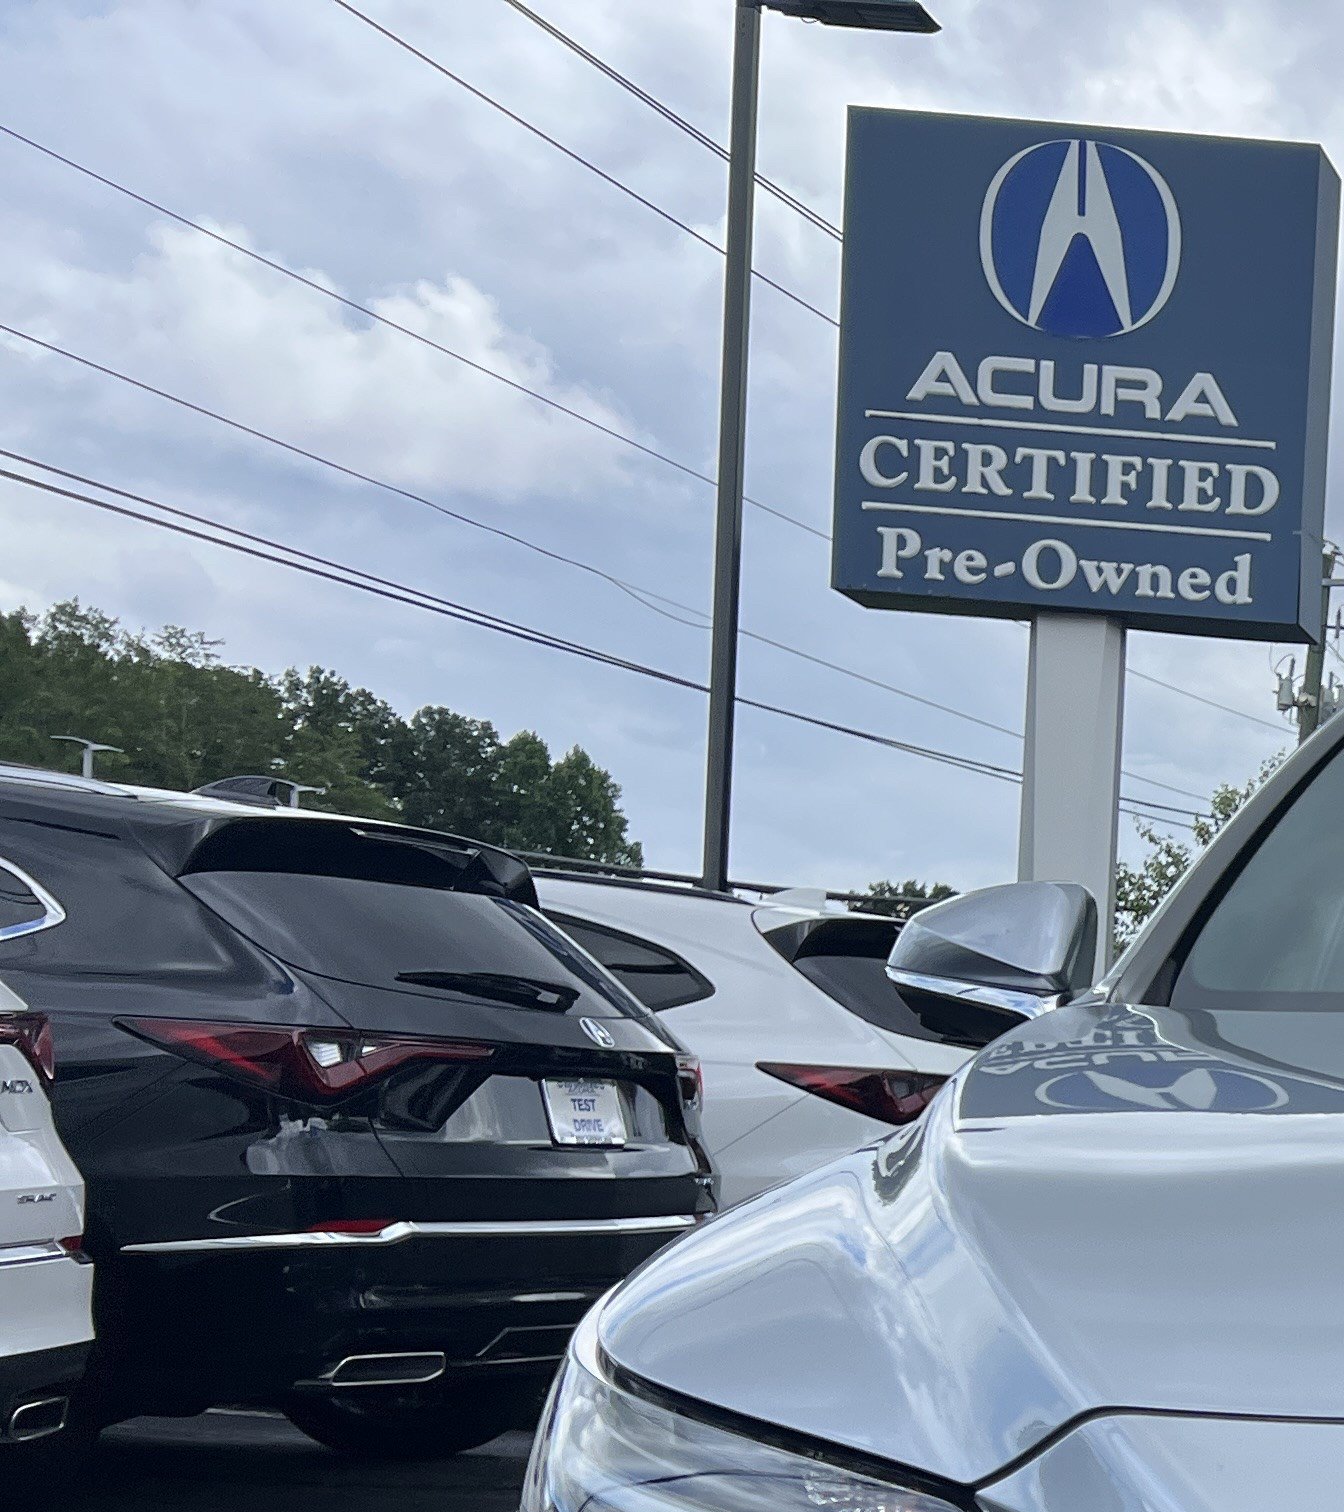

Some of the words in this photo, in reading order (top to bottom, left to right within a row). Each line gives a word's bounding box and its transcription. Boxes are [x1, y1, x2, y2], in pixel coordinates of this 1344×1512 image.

[906, 351, 1239, 427] ACURA
[859, 435, 1281, 516] CERTIFIED
[876, 526, 1253, 606] Pre-Owned
[571, 1098, 596, 1112] TEST
[573, 1118, 604, 1133] DRIVE
